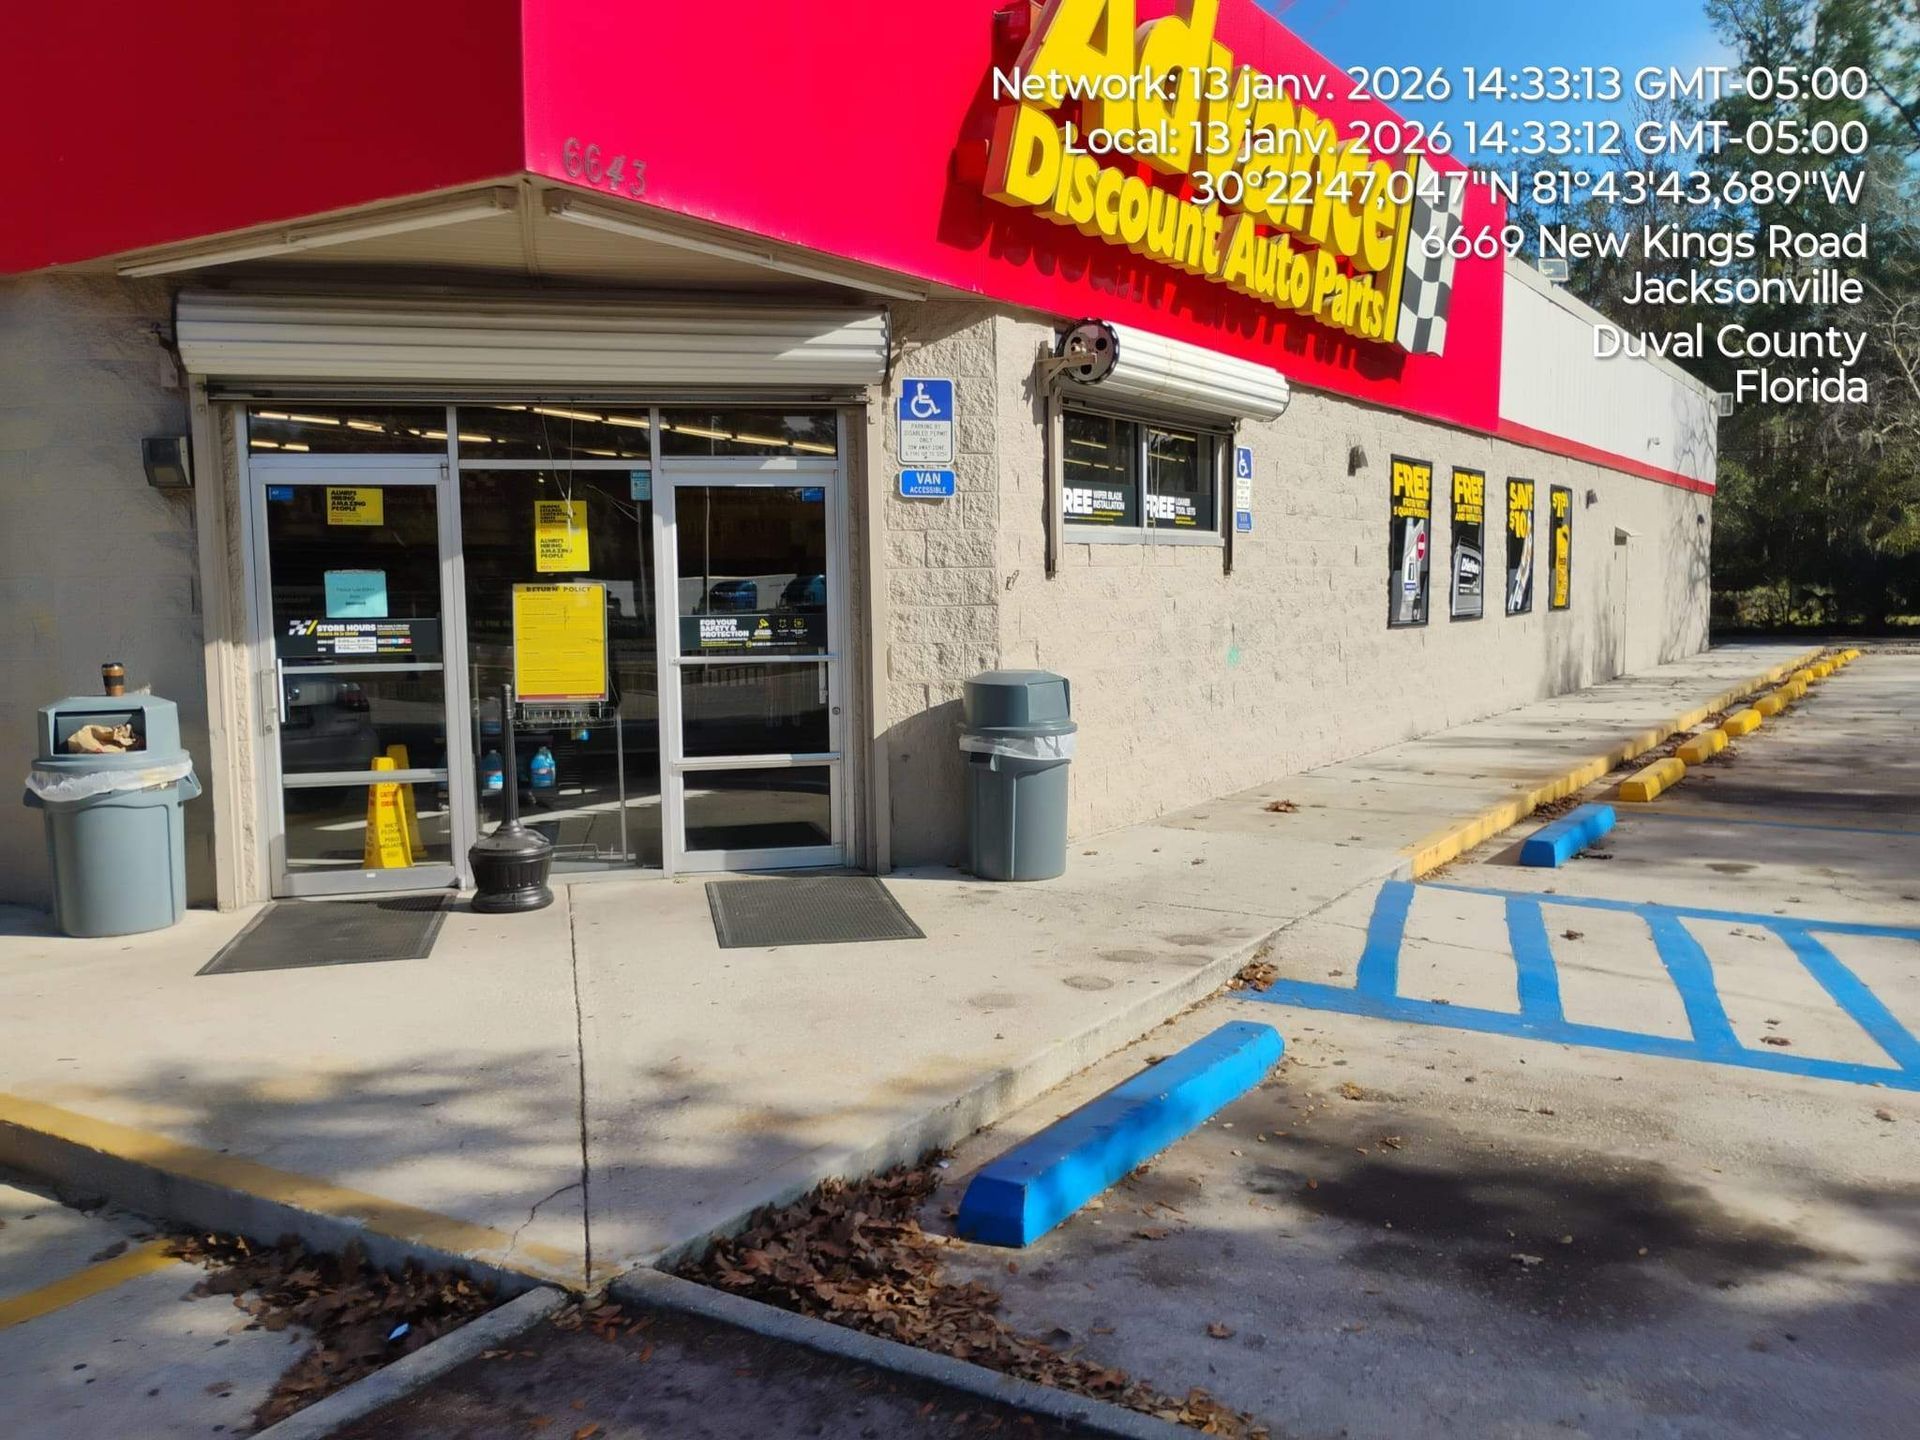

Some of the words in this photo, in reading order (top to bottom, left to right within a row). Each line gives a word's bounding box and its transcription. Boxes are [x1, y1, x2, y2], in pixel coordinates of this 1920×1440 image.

[1008, 0, 1398, 272] Advance
[563, 136, 648, 197] 6643
[1000, 106, 1225, 276] Discount
[1224, 214, 1310, 307] Auto
[1311, 250, 1385, 340] Parts
[909, 486, 947, 494] ACCESSIBLE
[916, 472, 941, 485] VAN
[1393, 461, 1430, 500] FREE
[1454, 471, 1484, 506] FREE
[1063, 487, 1093, 515] REE
[1093, 500, 1125, 511] INSTALLATION
[1146, 494, 1176, 520] FREE
[1509, 482, 1534, 511] SAVE
[1509, 511, 1527, 539] $10
[317, 624, 346, 632] STORE
[347, 623, 376, 632] HOURS
[700, 618, 716, 626] FOR
[717, 618, 738, 626] YOUR
